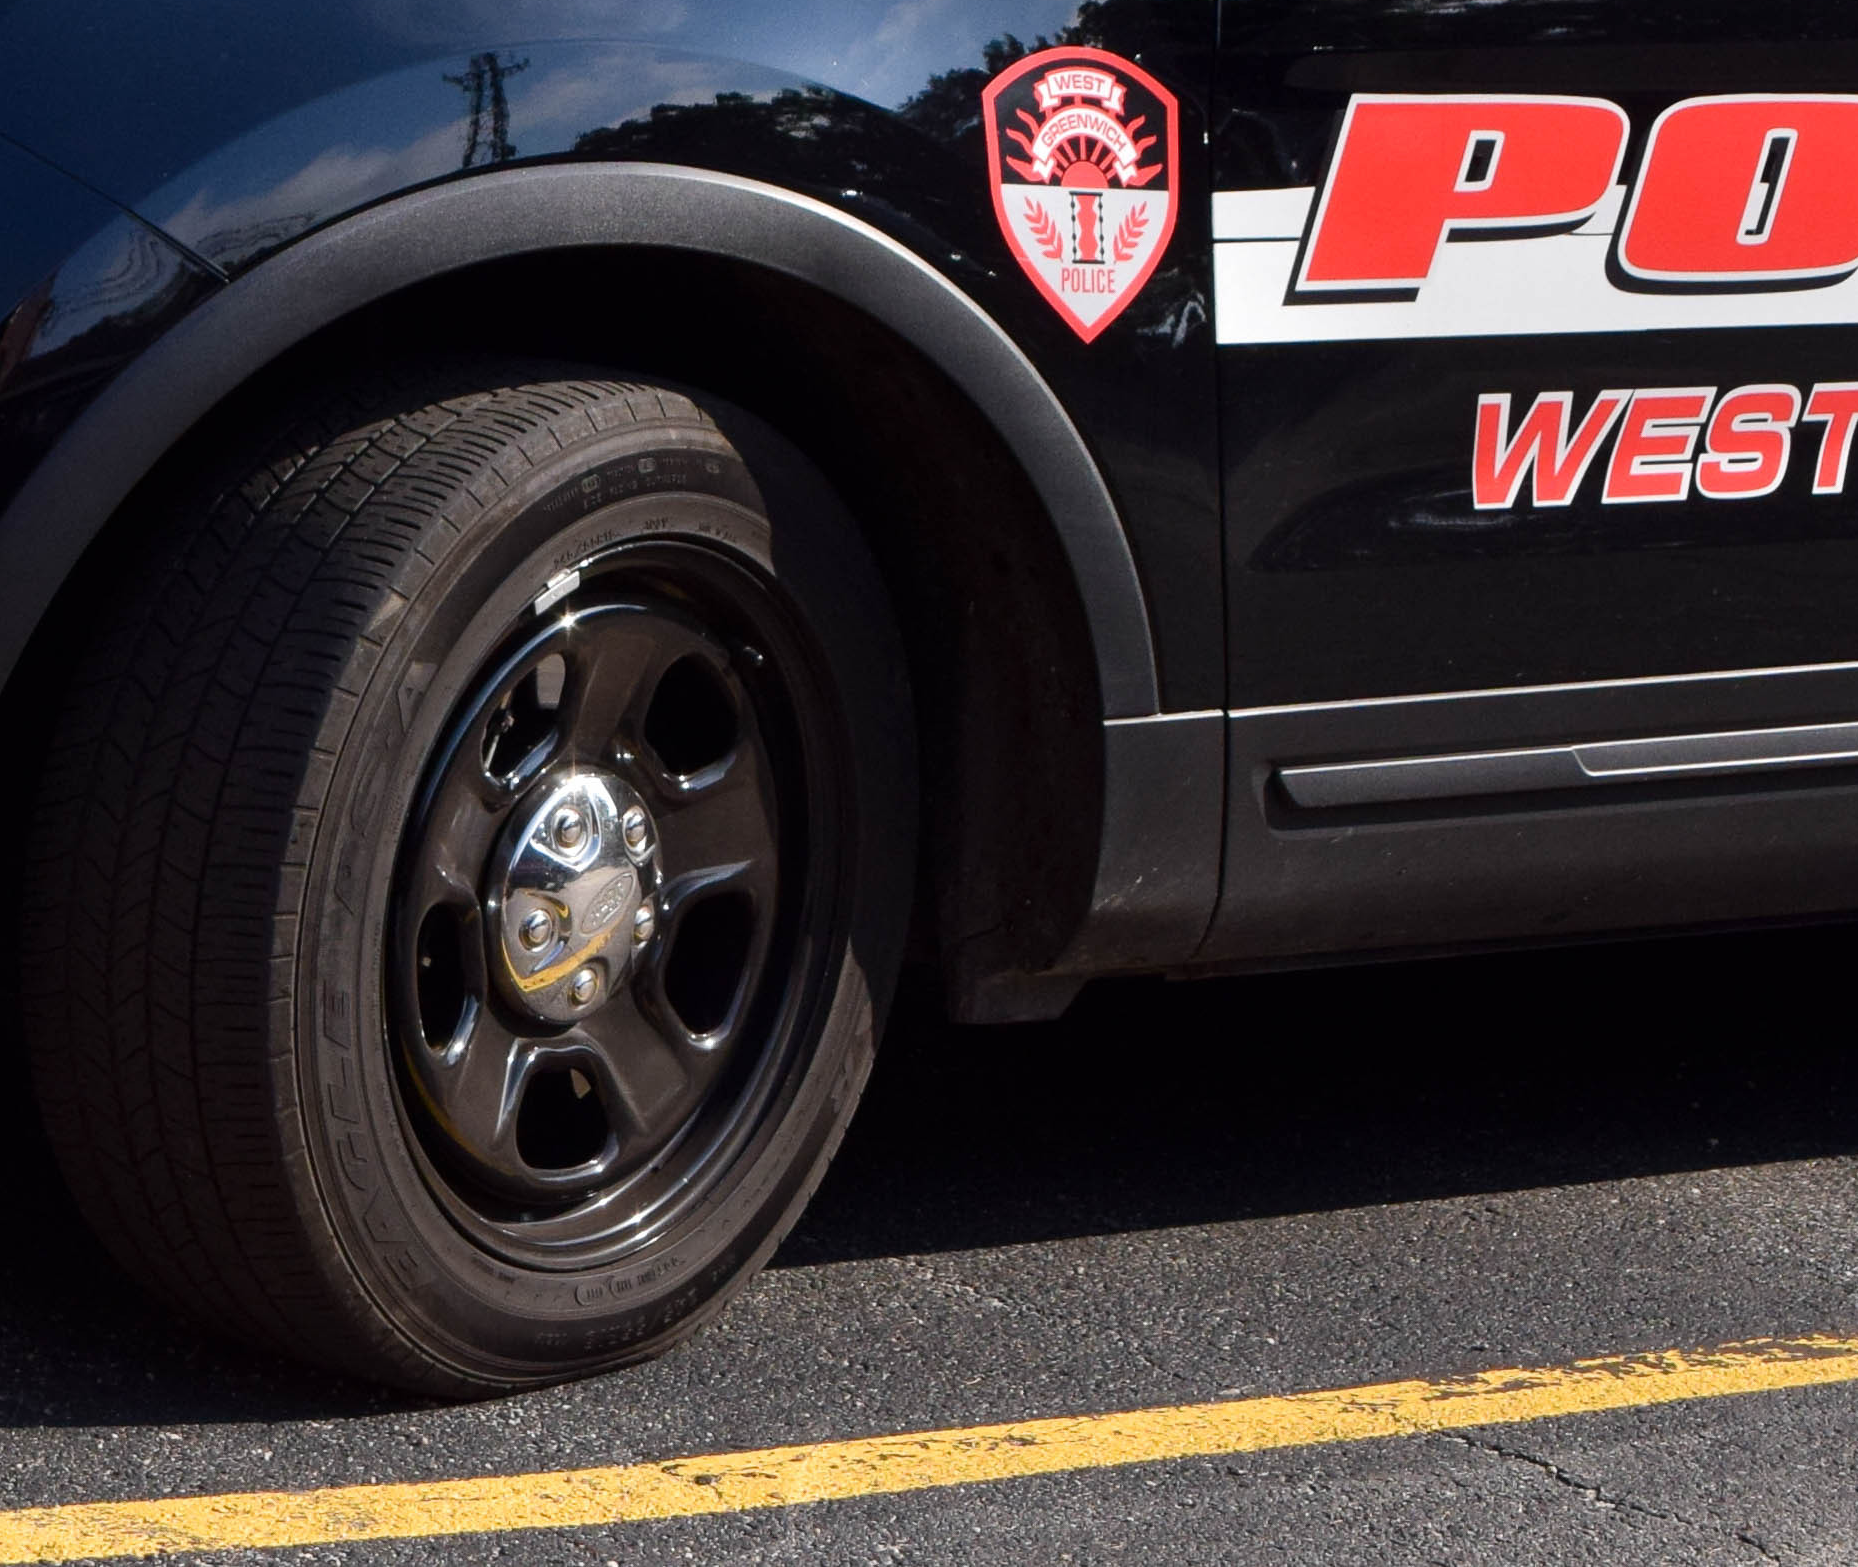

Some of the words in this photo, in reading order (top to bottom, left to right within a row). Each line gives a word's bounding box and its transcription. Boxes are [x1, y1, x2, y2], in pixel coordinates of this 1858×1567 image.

[1053, 74, 1106, 91] WEST
[1042, 114, 1128, 153] GREENWICH
[1061, 267, 1116, 294] POLICE
